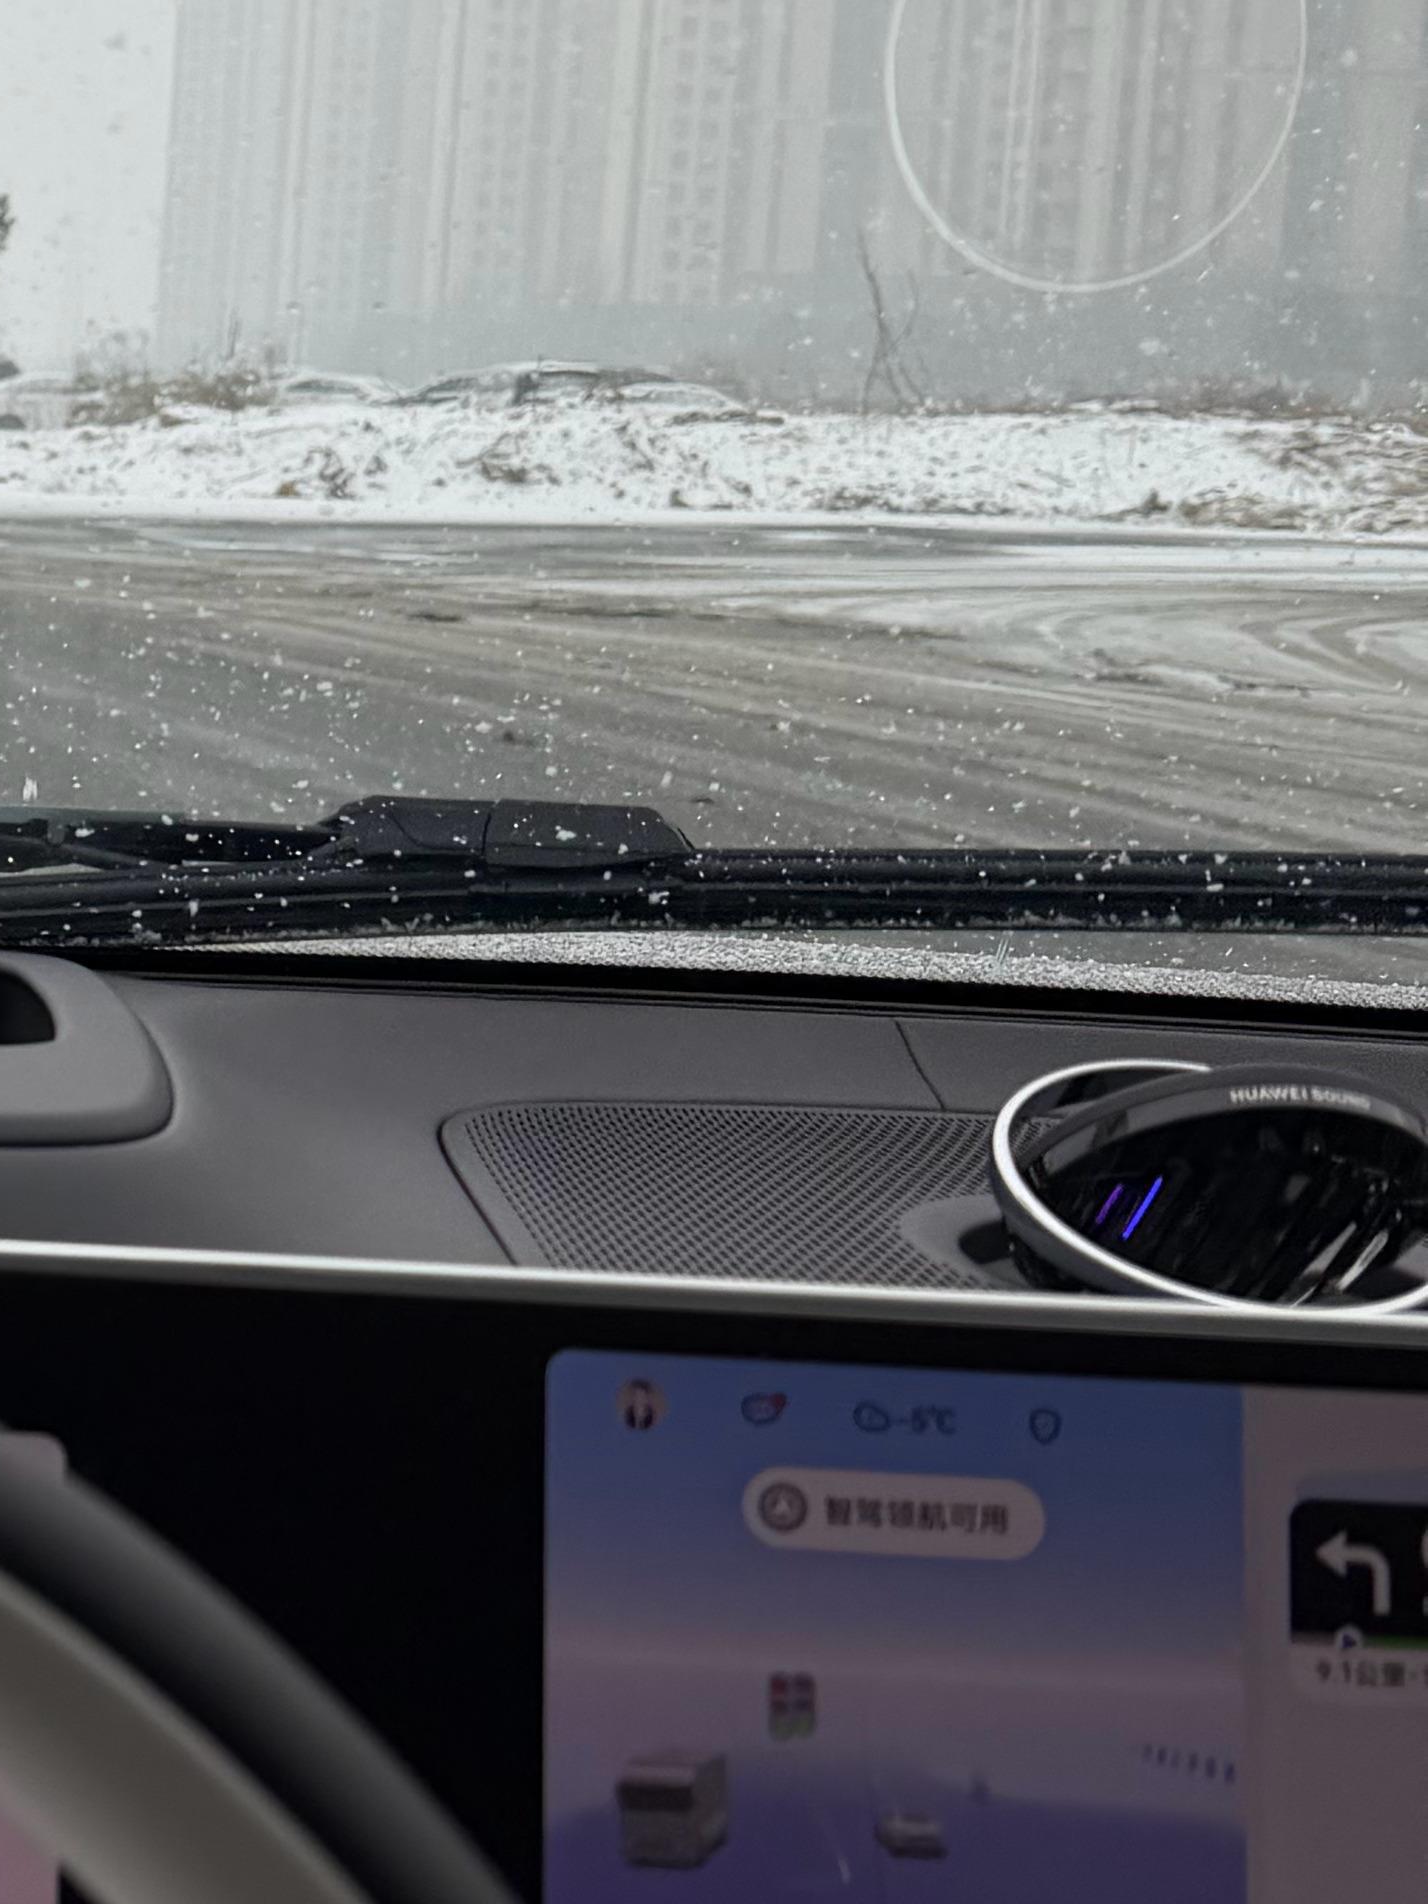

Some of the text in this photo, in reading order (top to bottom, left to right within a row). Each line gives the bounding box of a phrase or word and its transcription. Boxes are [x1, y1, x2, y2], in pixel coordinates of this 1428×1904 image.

[1229, 1084, 1308, 1104] HUAWEI
[825, 1496, 1009, 1536] 智驾领航可用
